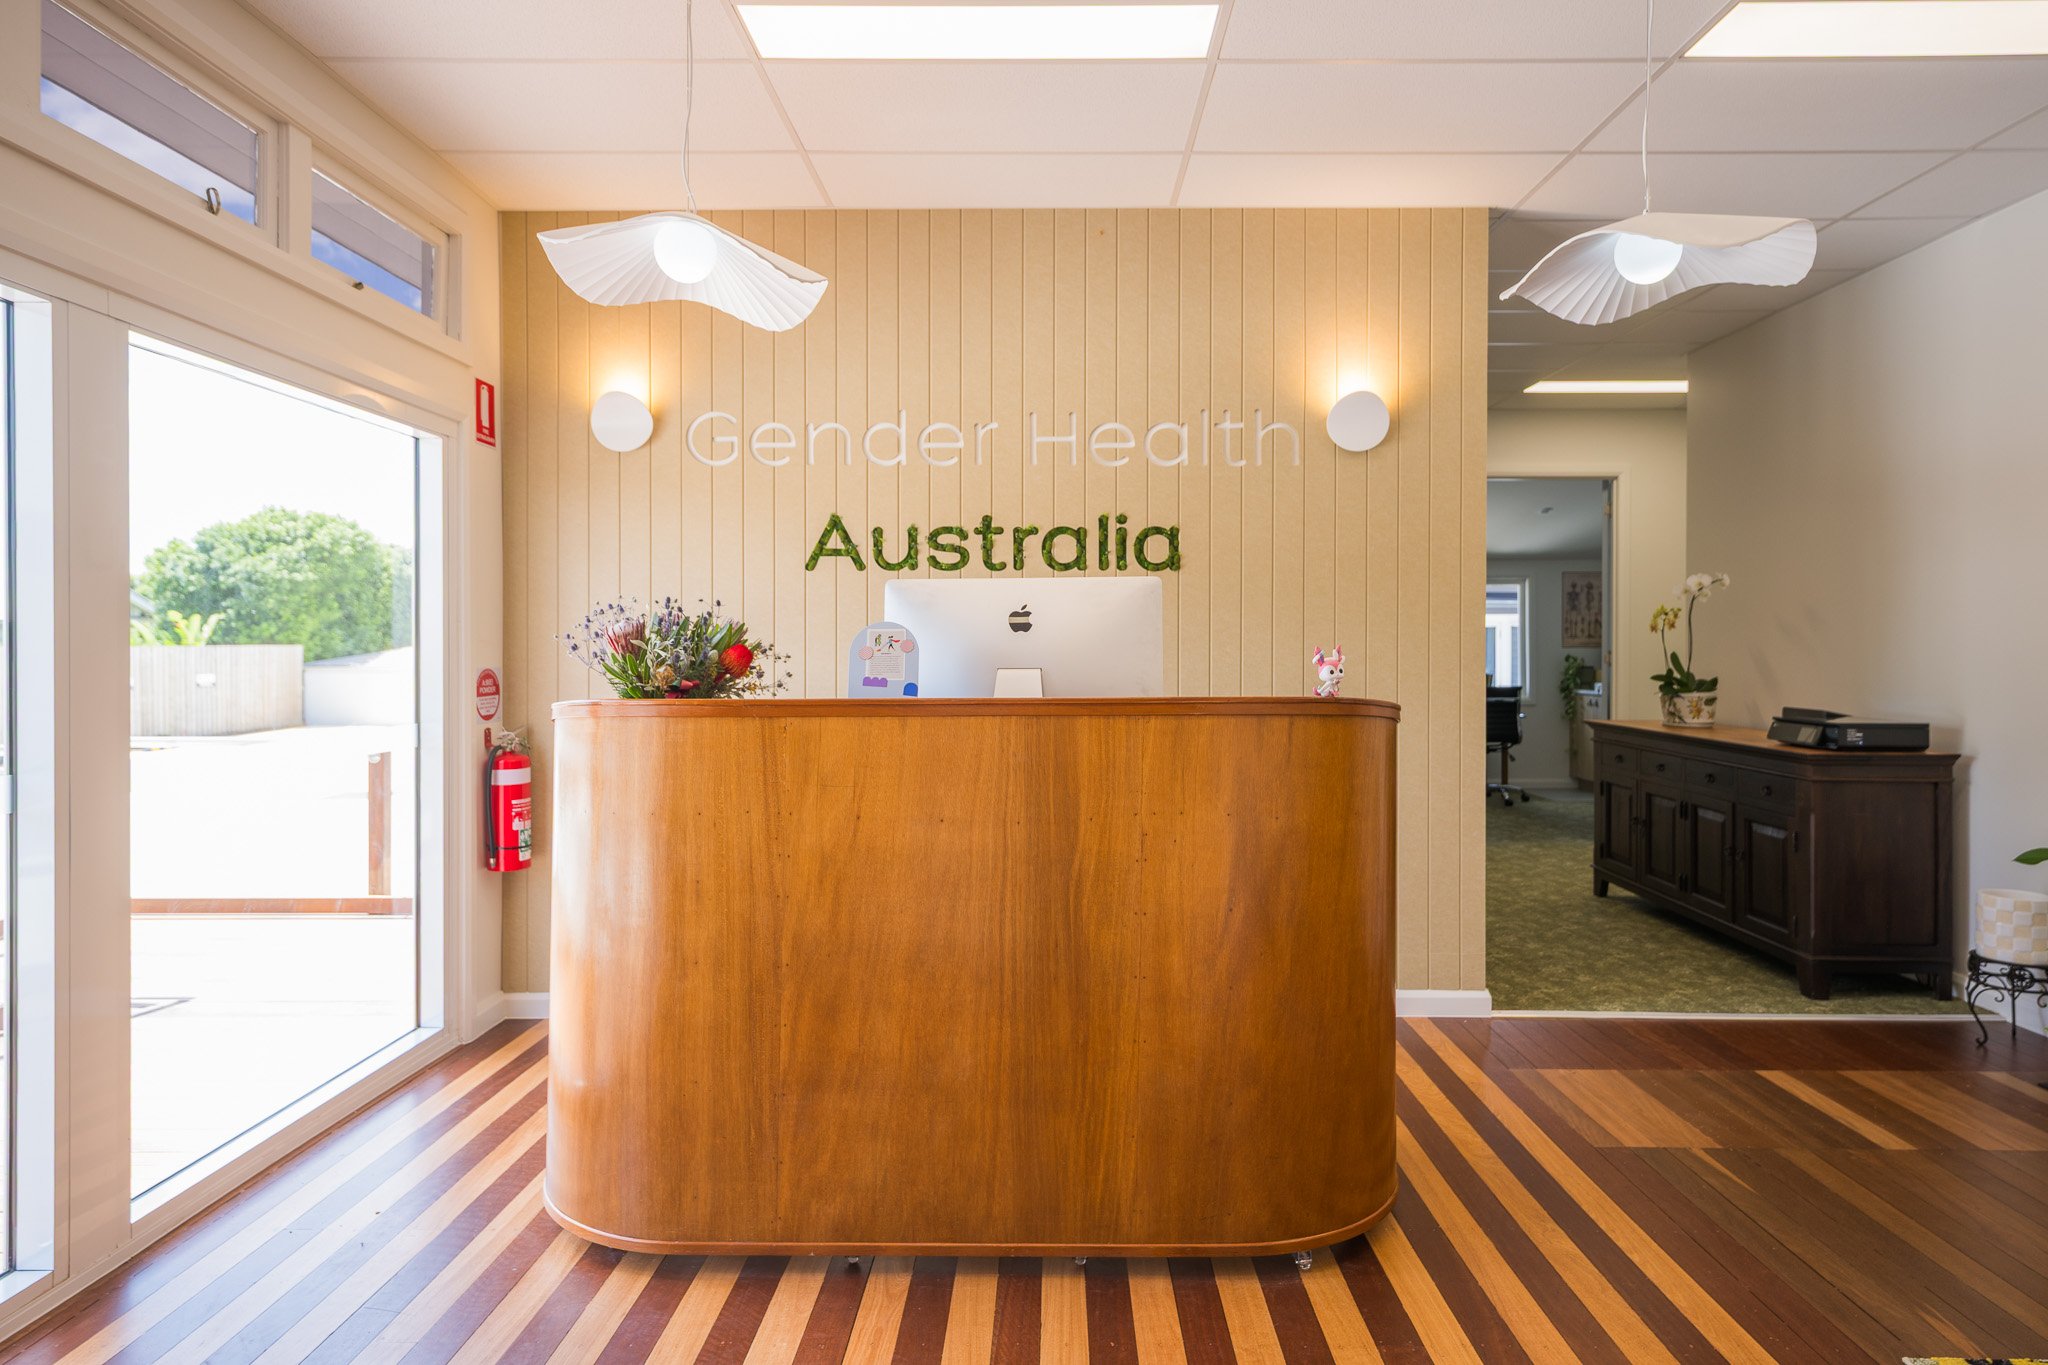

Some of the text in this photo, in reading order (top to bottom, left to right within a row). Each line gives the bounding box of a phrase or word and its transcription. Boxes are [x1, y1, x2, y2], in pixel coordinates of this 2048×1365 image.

[686, 408, 1300, 467] Gender Health
[804, 513, 1182, 572] Australia
